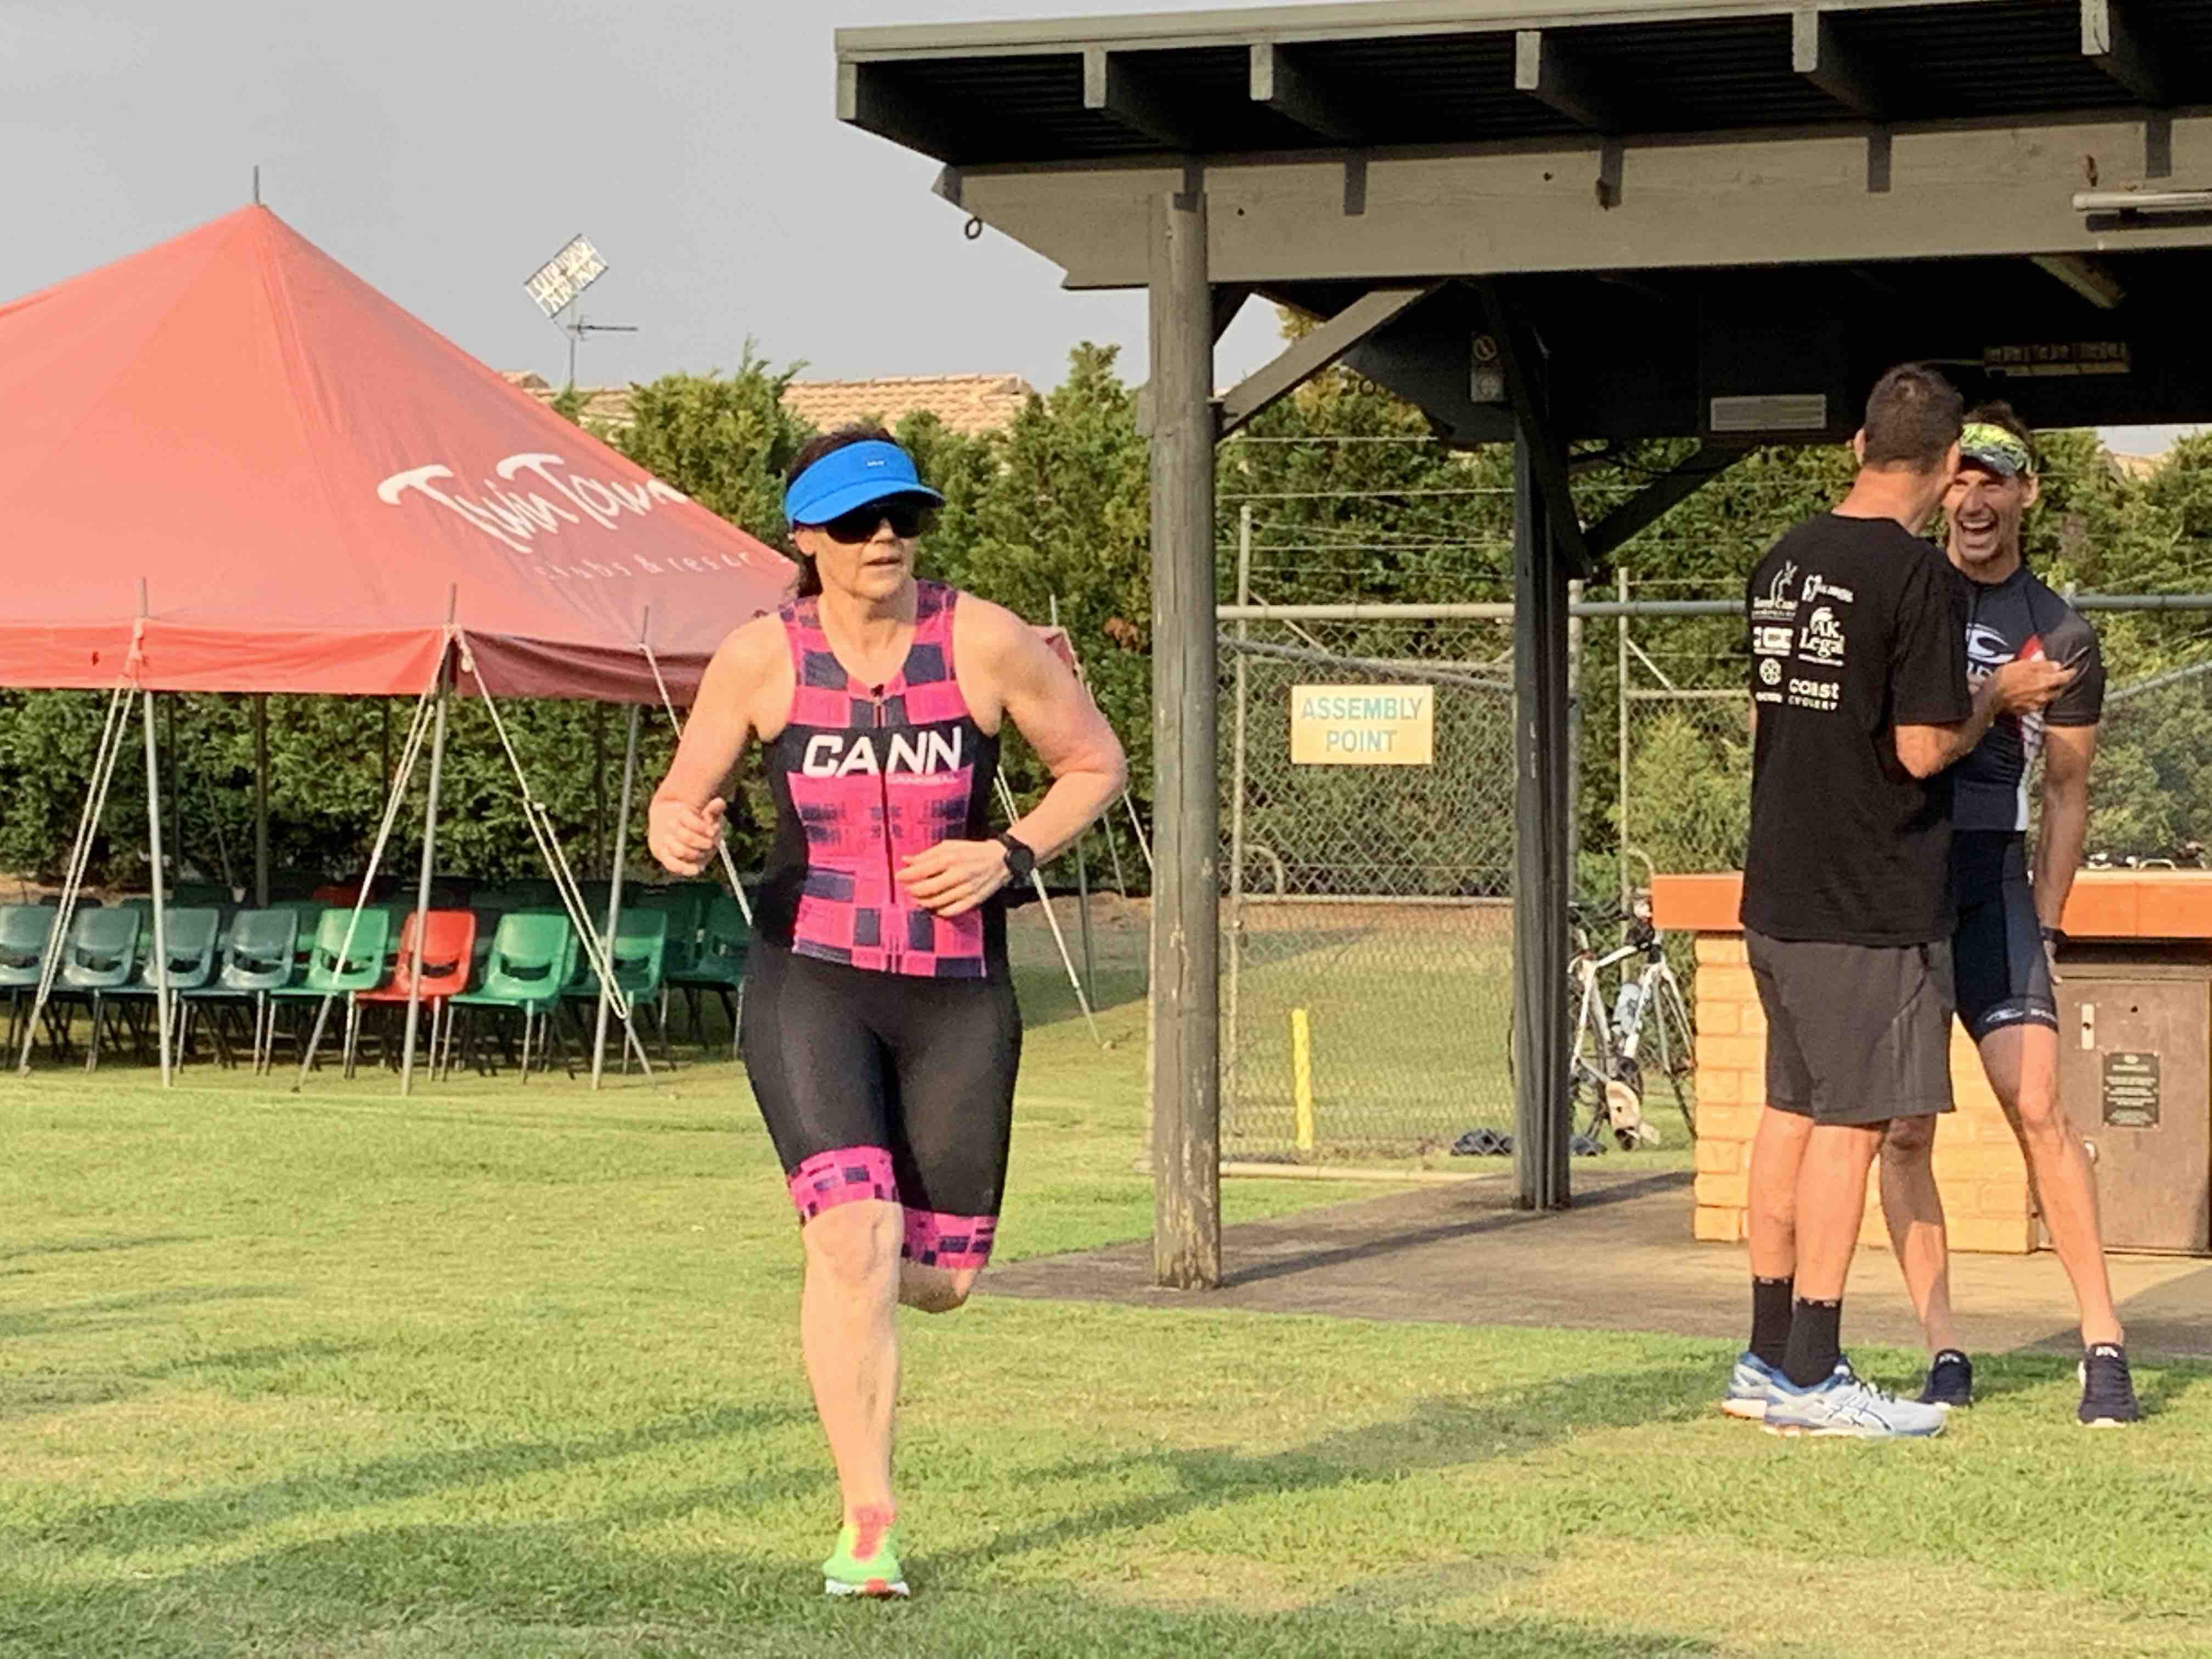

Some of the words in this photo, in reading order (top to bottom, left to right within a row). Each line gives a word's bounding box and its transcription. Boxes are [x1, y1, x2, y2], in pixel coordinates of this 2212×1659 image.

[1301, 697, 1425, 720] ASSEMBLY
[802, 726, 962, 779] CANN
[1325, 729, 1398, 753] POINT
